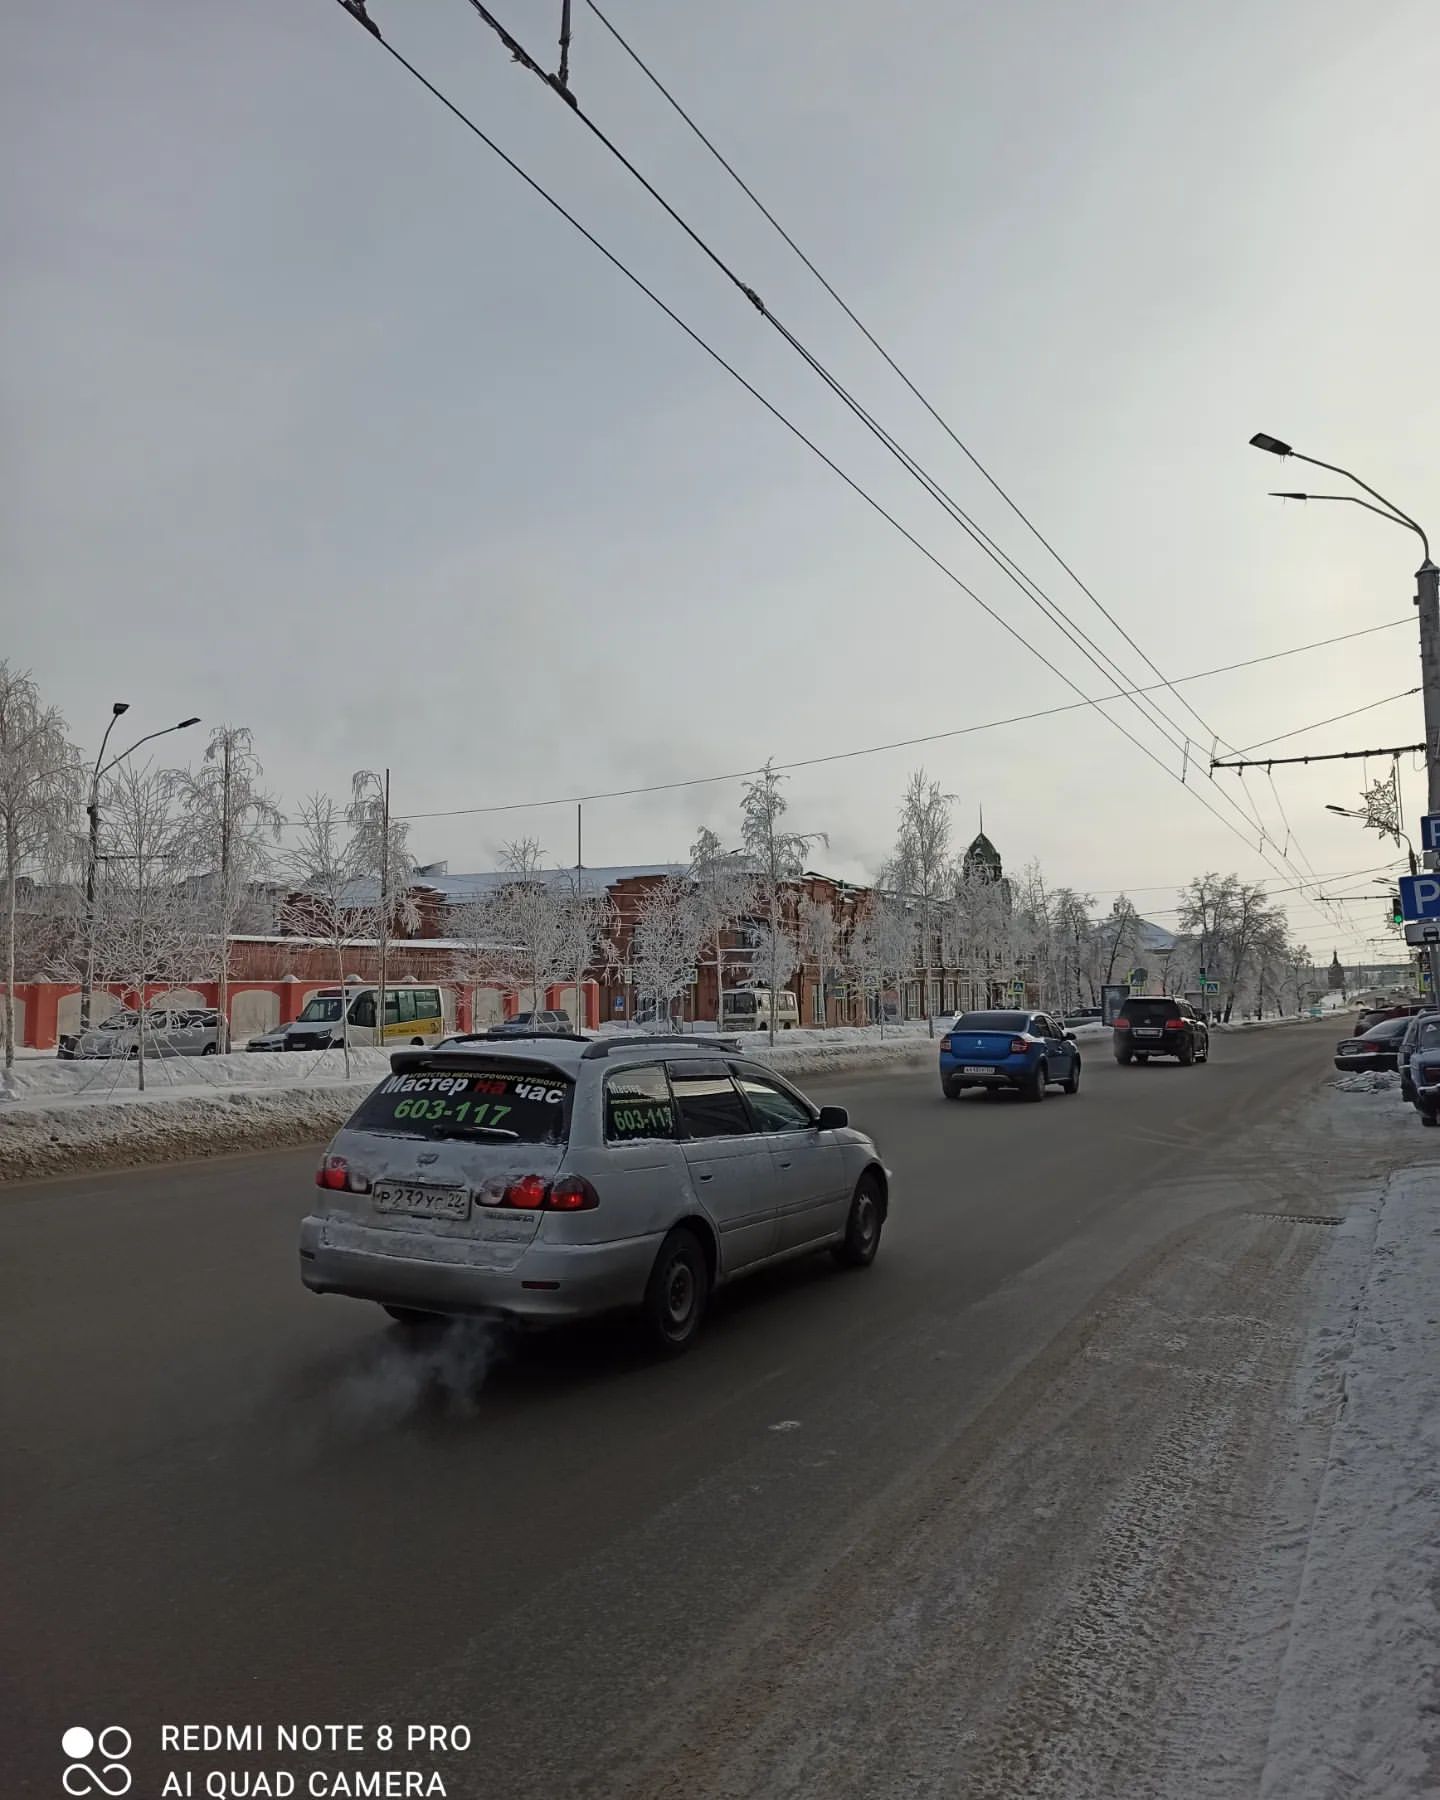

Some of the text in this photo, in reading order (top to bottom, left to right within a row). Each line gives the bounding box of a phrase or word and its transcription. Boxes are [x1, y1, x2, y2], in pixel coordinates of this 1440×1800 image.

[1413, 879, 1440, 914] P
[380, 1074, 565, 1104] Мастер на час
[525, 1077, 568, 1089] РЕМОНТА
[393, 1099, 512, 1126] 603-117
[613, 1107, 673, 1131] 603-117
